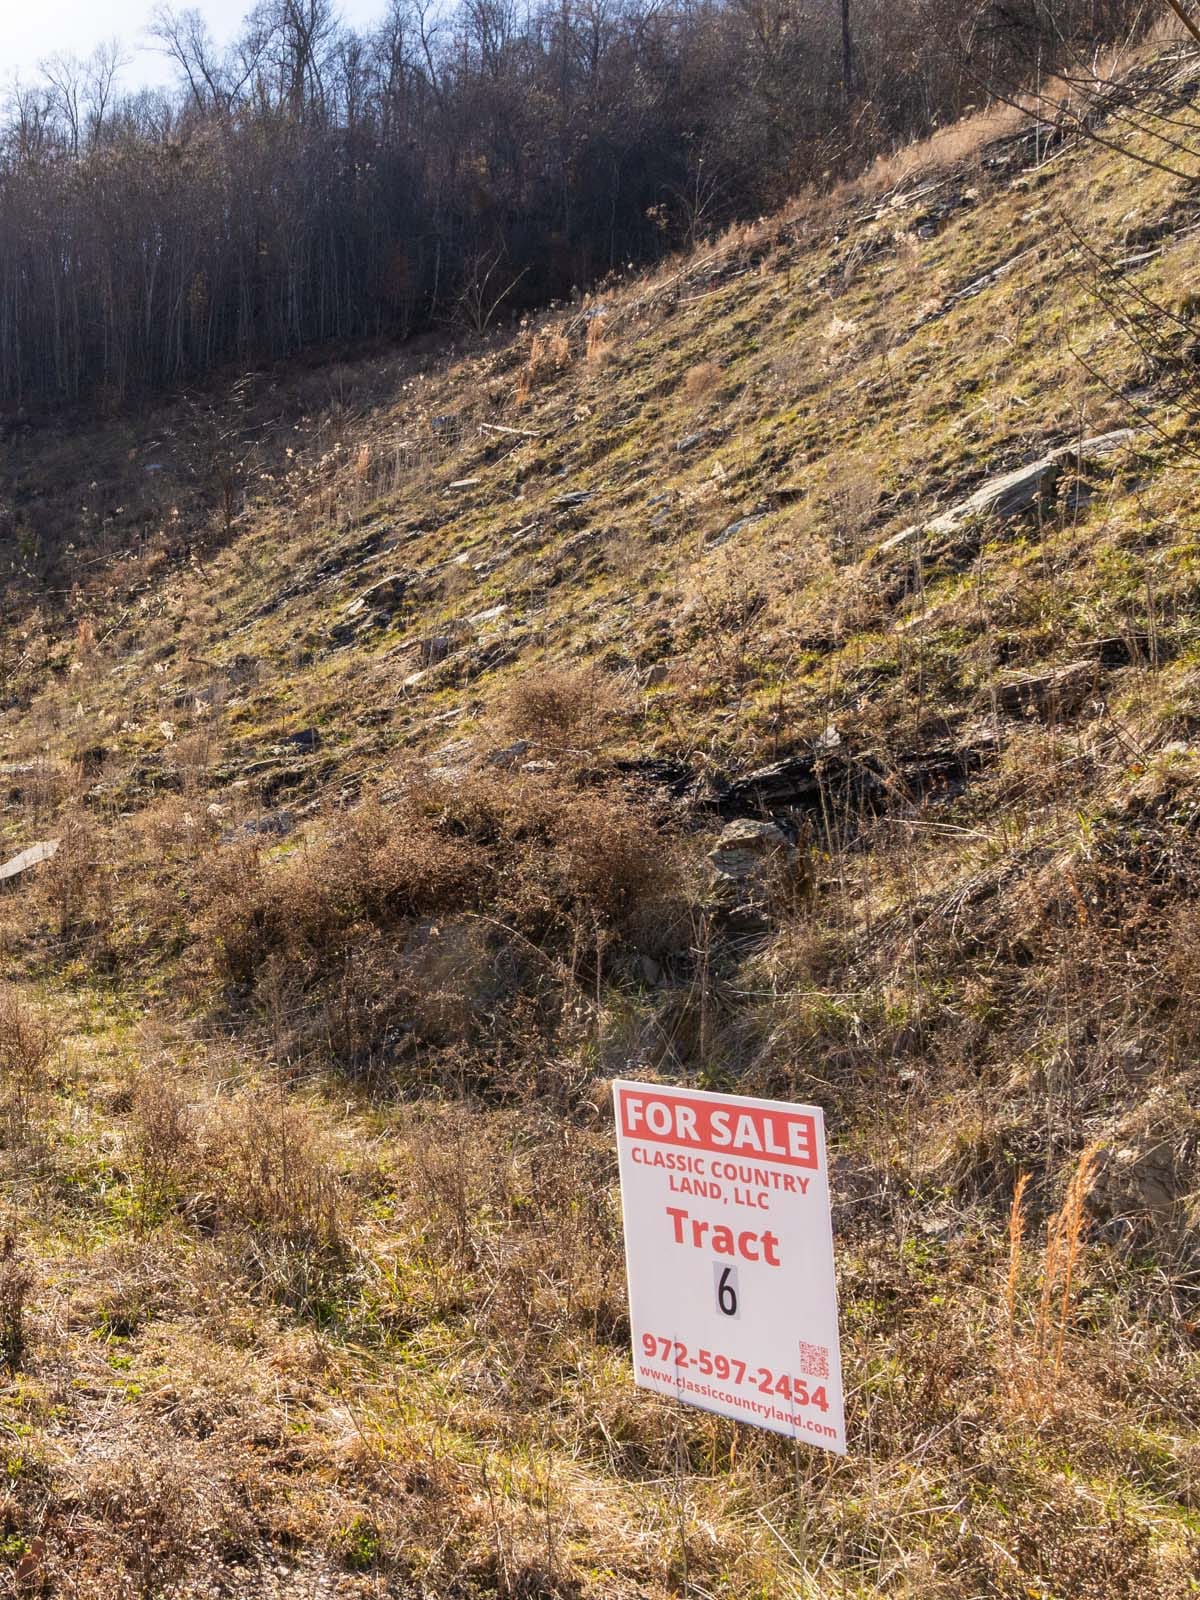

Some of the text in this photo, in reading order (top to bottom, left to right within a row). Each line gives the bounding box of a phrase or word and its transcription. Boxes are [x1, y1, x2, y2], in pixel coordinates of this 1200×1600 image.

[626, 1098, 810, 1160] FOR SALE
[631, 1147, 810, 1195] CLASSIC COUNTRY
[669, 1175, 769, 1210] LAND, LLC
[666, 1207, 781, 1267] Tract
[717, 1267, 738, 1317] 6
[639, 1365, 837, 1439] www.classiccountryland.com
[642, 1333, 829, 1413] 972-597-2454
